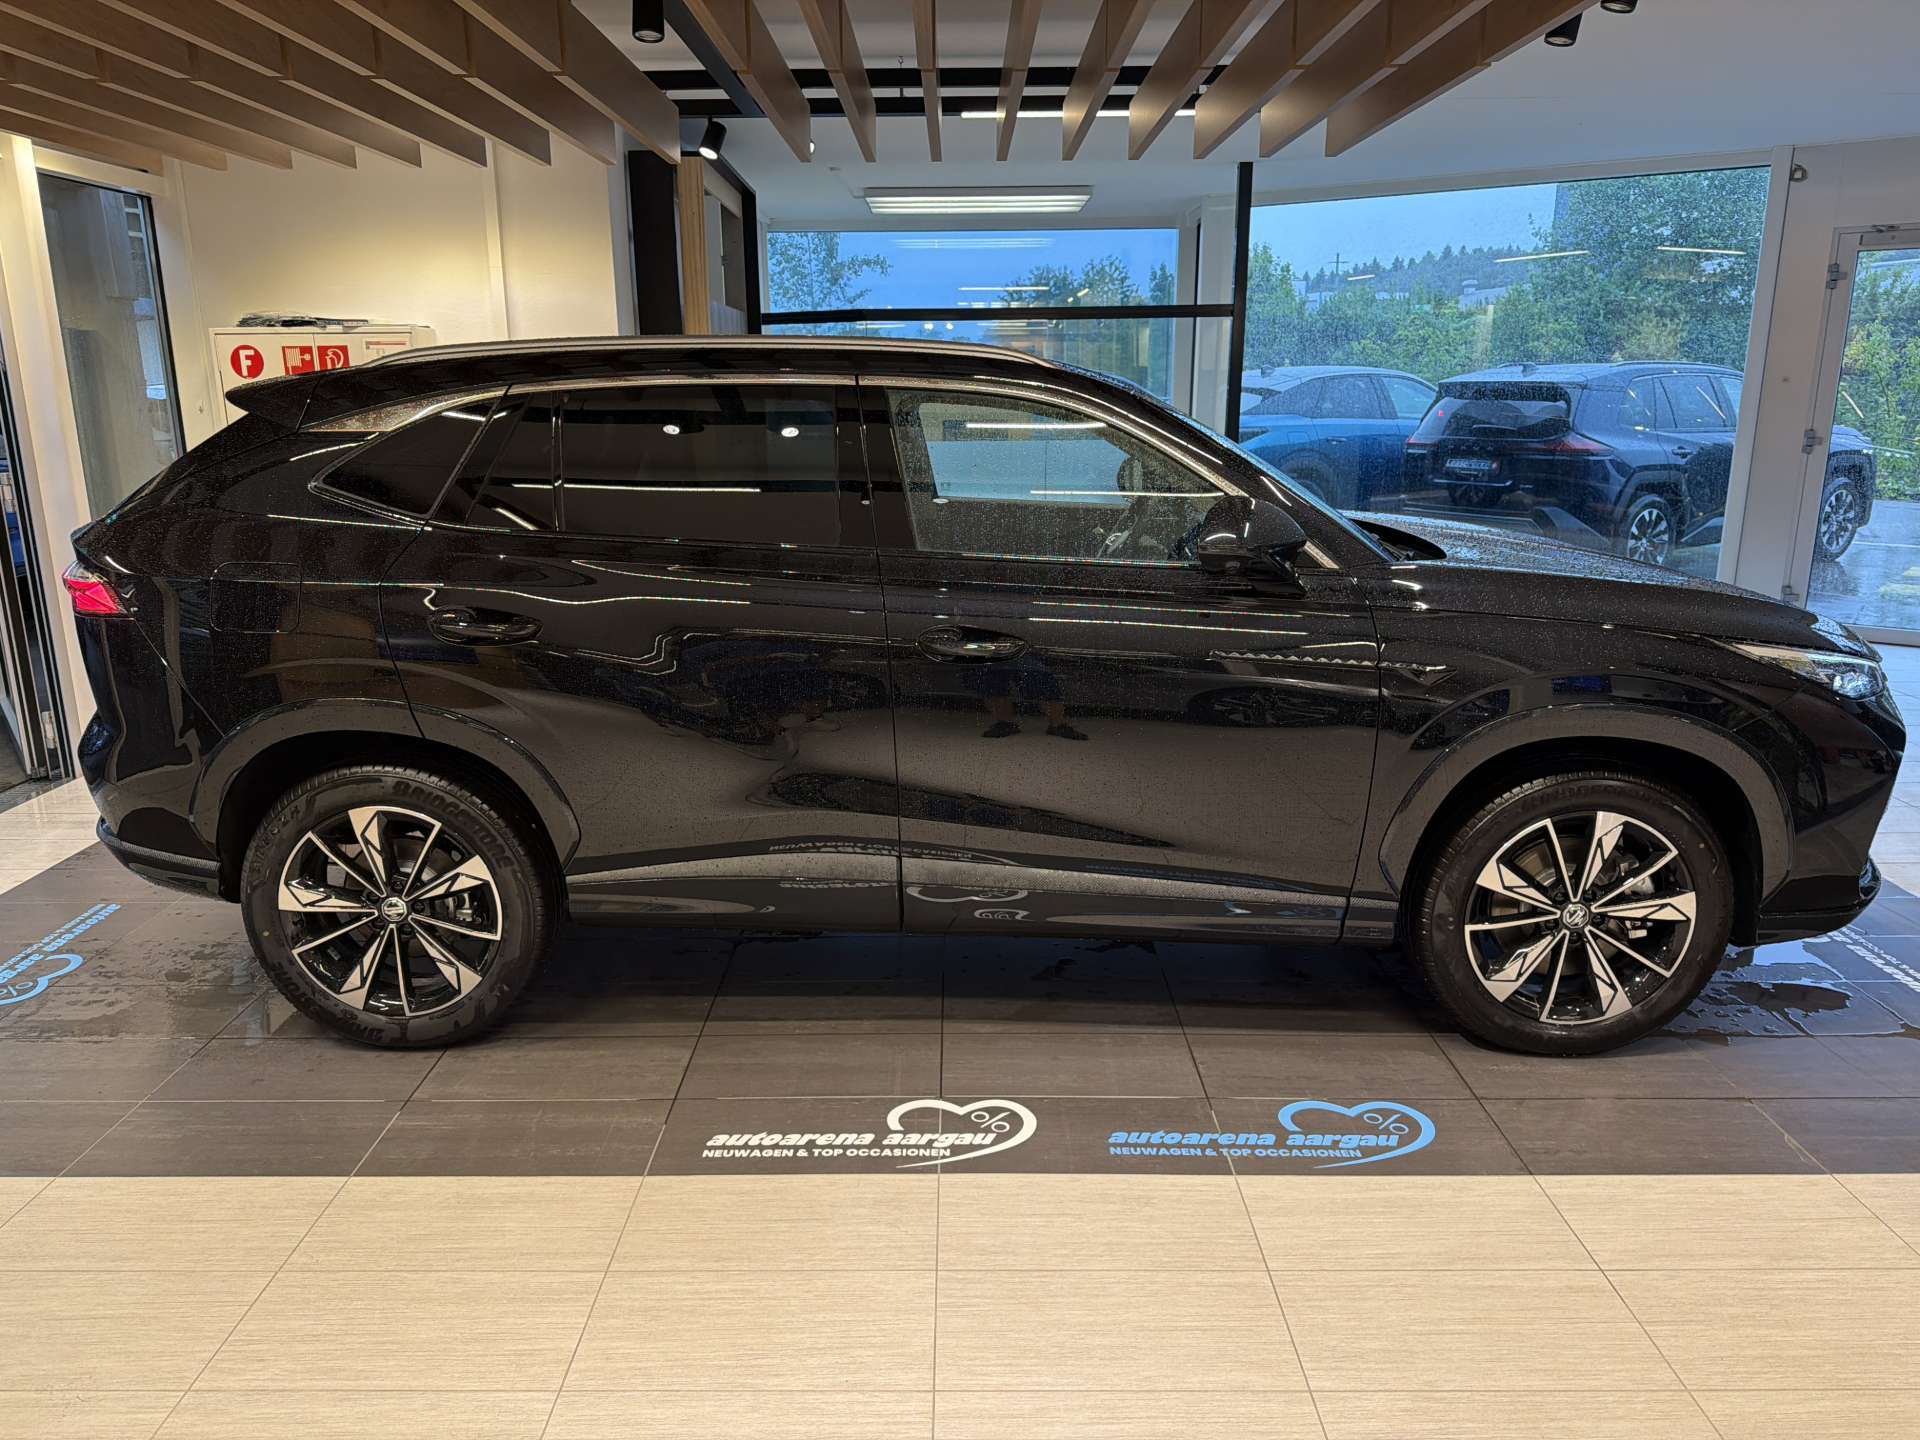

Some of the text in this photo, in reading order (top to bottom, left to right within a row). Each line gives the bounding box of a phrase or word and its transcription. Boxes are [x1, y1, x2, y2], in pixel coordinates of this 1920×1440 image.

[239, 350, 254, 376] F
[706, 1131, 997, 1148] autoarena aargau
[1108, 1130, 1399, 1148] autoarena aargau
[702, 1148, 951, 1158] NEUWAGEN & TOP OCCASIONEN
[1109, 1147, 1361, 1158] NEUWAGEN & TOP OCCASIONEN
